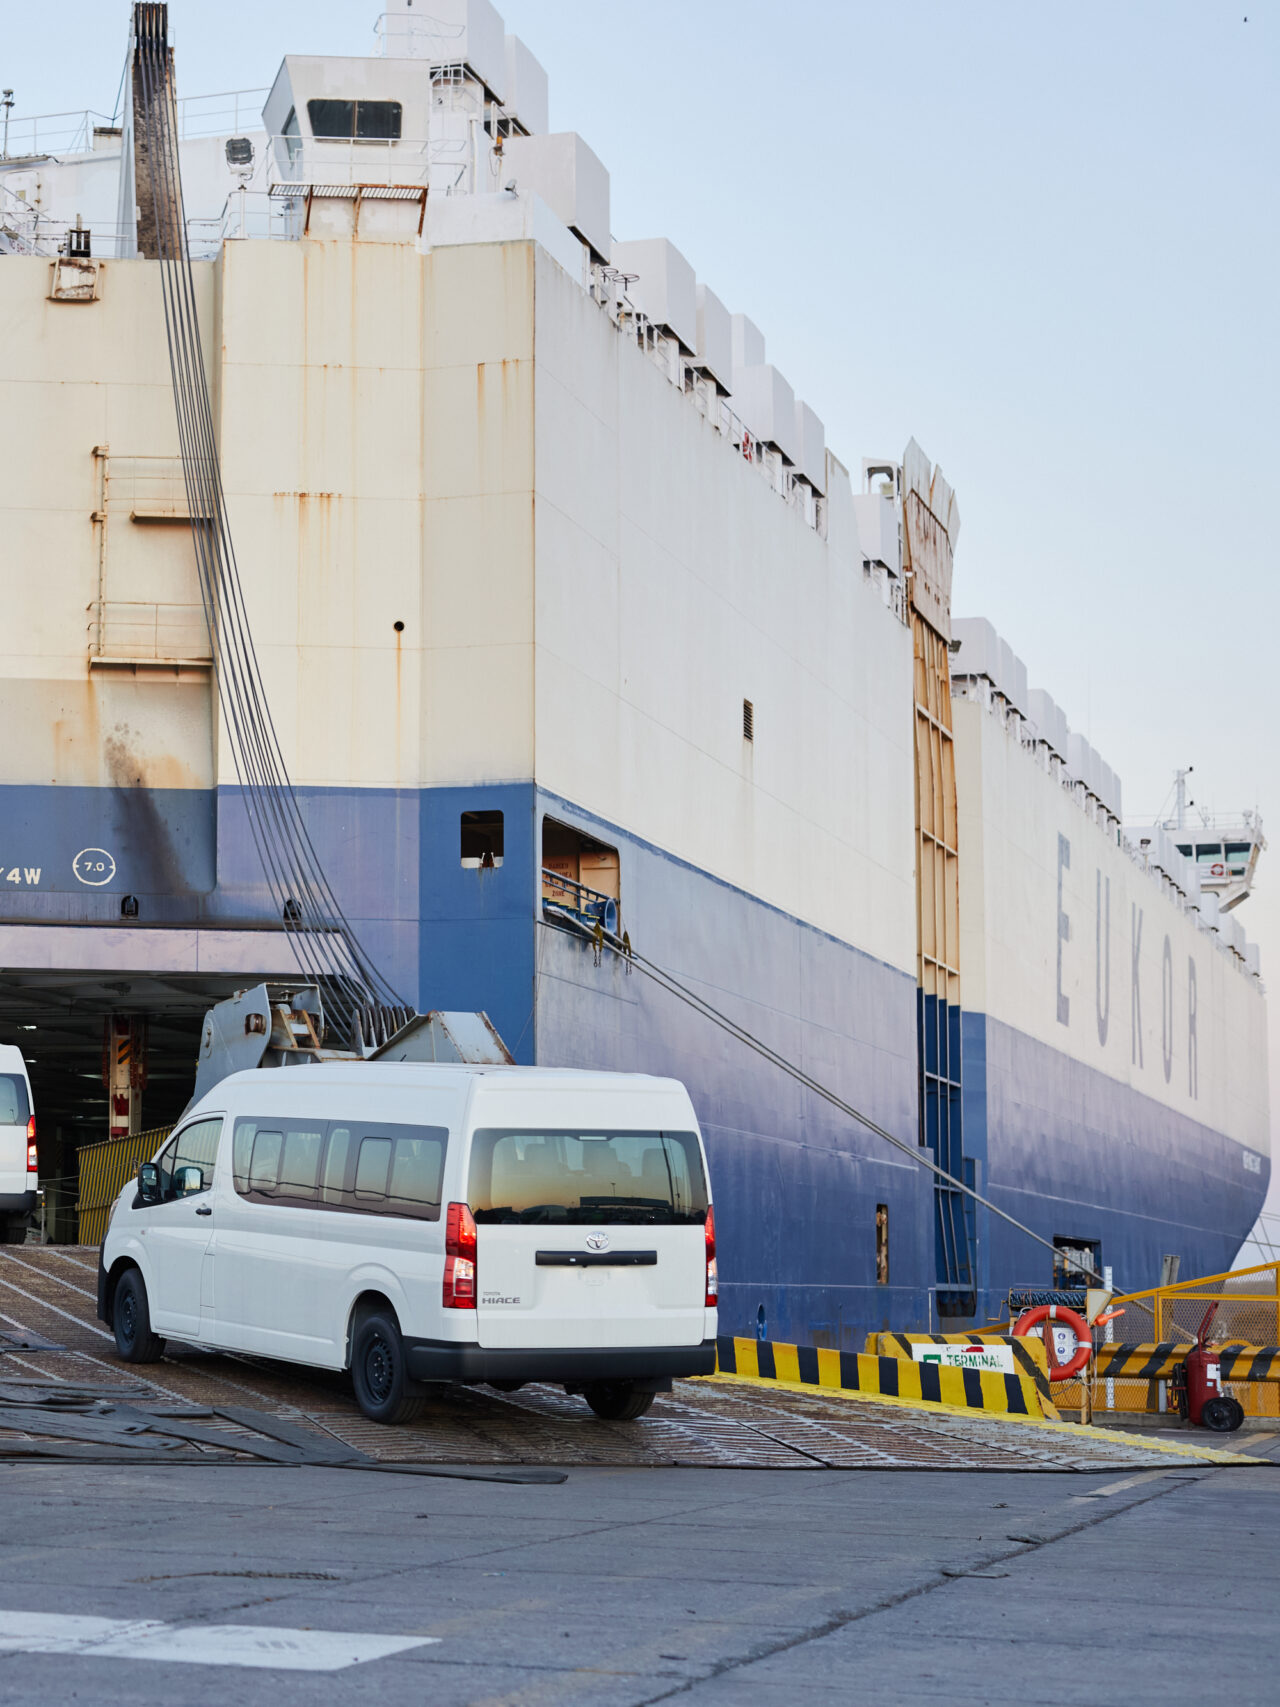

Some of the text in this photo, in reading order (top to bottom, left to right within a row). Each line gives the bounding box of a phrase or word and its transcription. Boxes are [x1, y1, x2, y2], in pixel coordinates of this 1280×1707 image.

[84, 862, 105, 872] 7.0
[1056, 831, 1198, 1100] EUKOR
[947, 1354, 1003, 1368] TERMINAL
